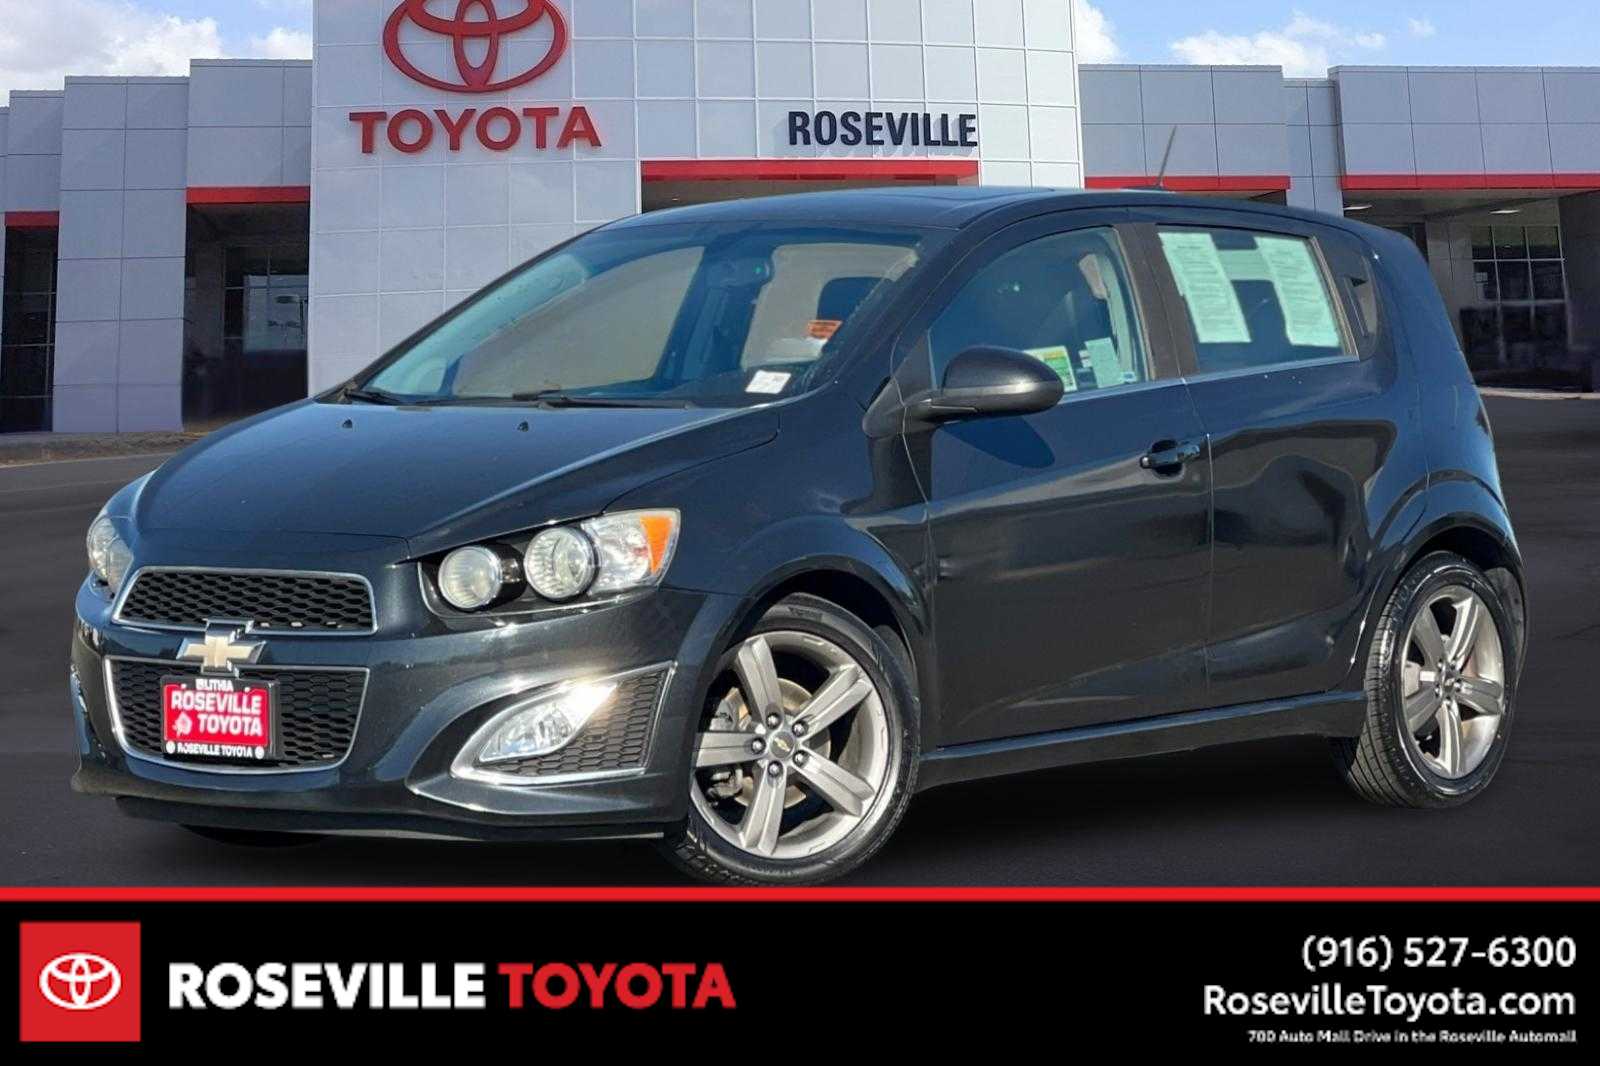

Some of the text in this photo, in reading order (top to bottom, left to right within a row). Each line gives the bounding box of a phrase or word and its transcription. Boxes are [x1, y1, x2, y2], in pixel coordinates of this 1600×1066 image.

[348, 105, 602, 154] TOYOTA
[788, 110, 978, 148] ROSEVILLE
[171, 690, 262, 715] ROSEVILLE
[197, 713, 263, 737] TOYOTA
[177, 742, 253, 758] ROSEVILLE TOYOTA
